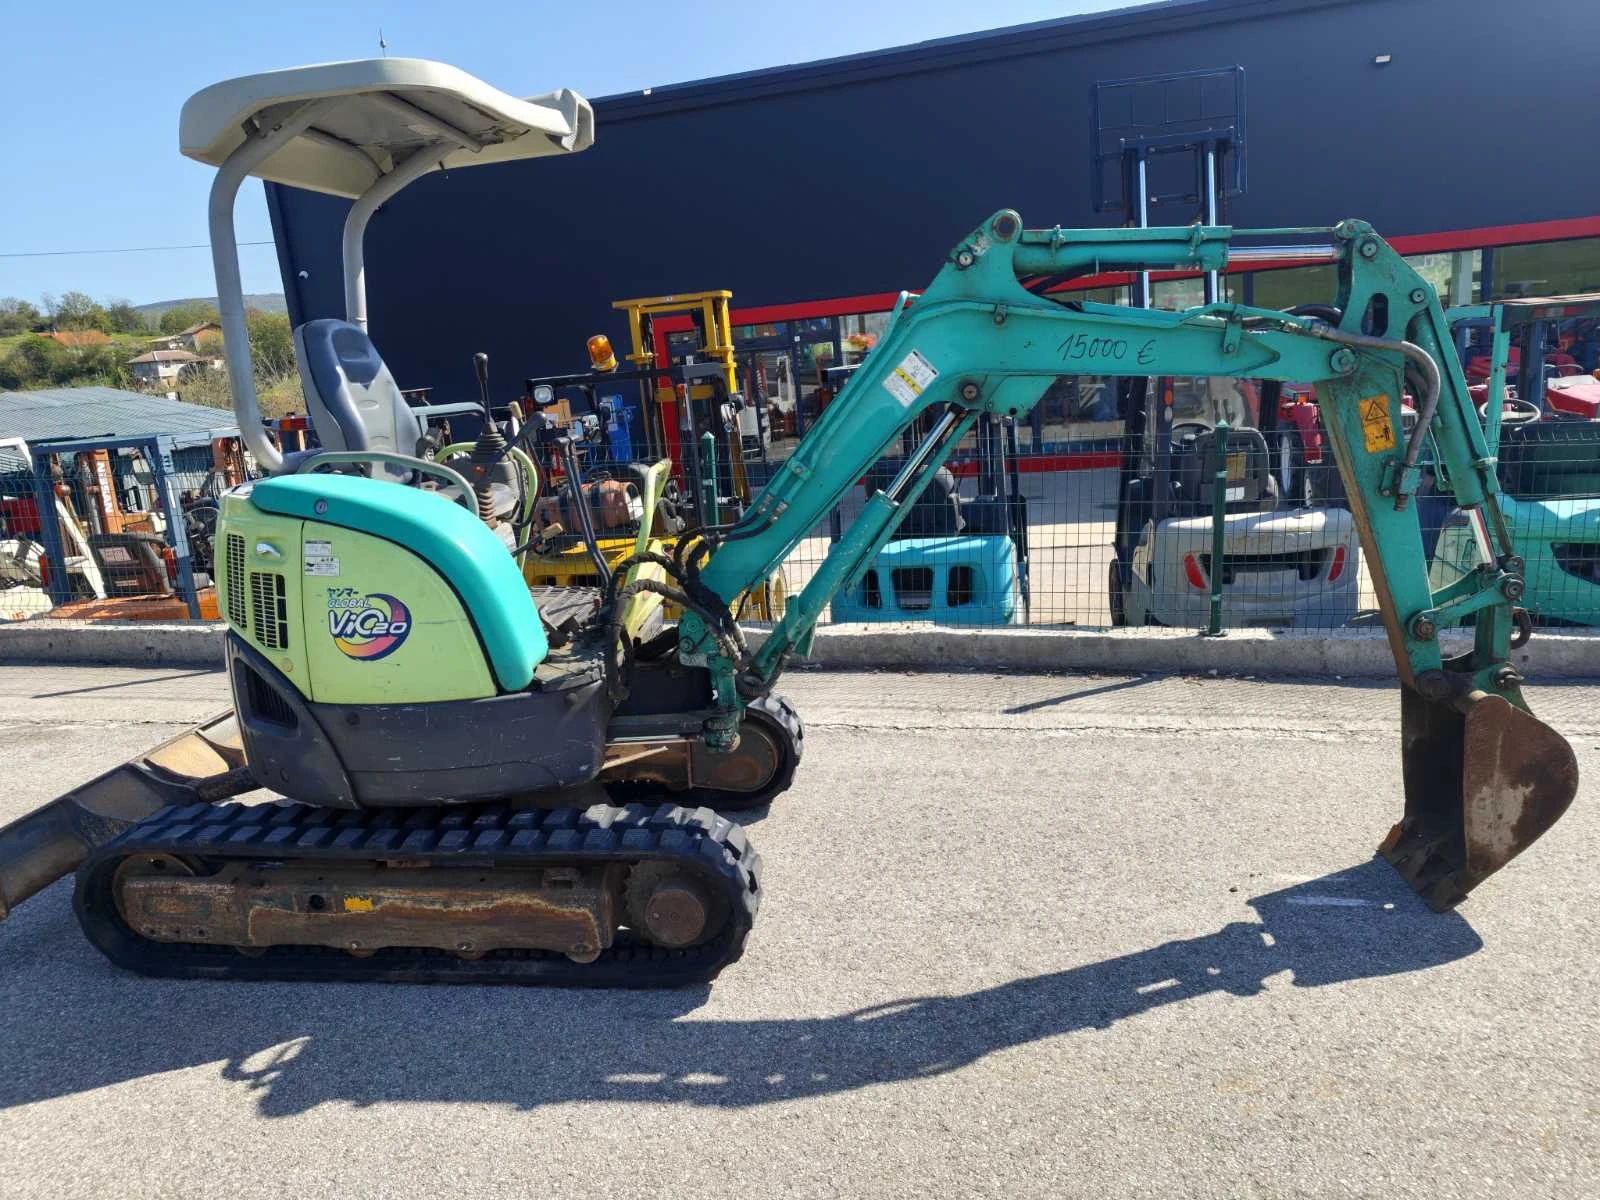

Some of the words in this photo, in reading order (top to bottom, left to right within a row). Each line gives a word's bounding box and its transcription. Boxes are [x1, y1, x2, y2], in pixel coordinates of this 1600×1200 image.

[1056, 333, 1128, 360] 15000
[1136, 339, 1156, 365] €
[96, 462, 113, 512] NISSAN
[326, 587, 359, 598] ヤンマー
[327, 598, 371, 608] GLOBAL
